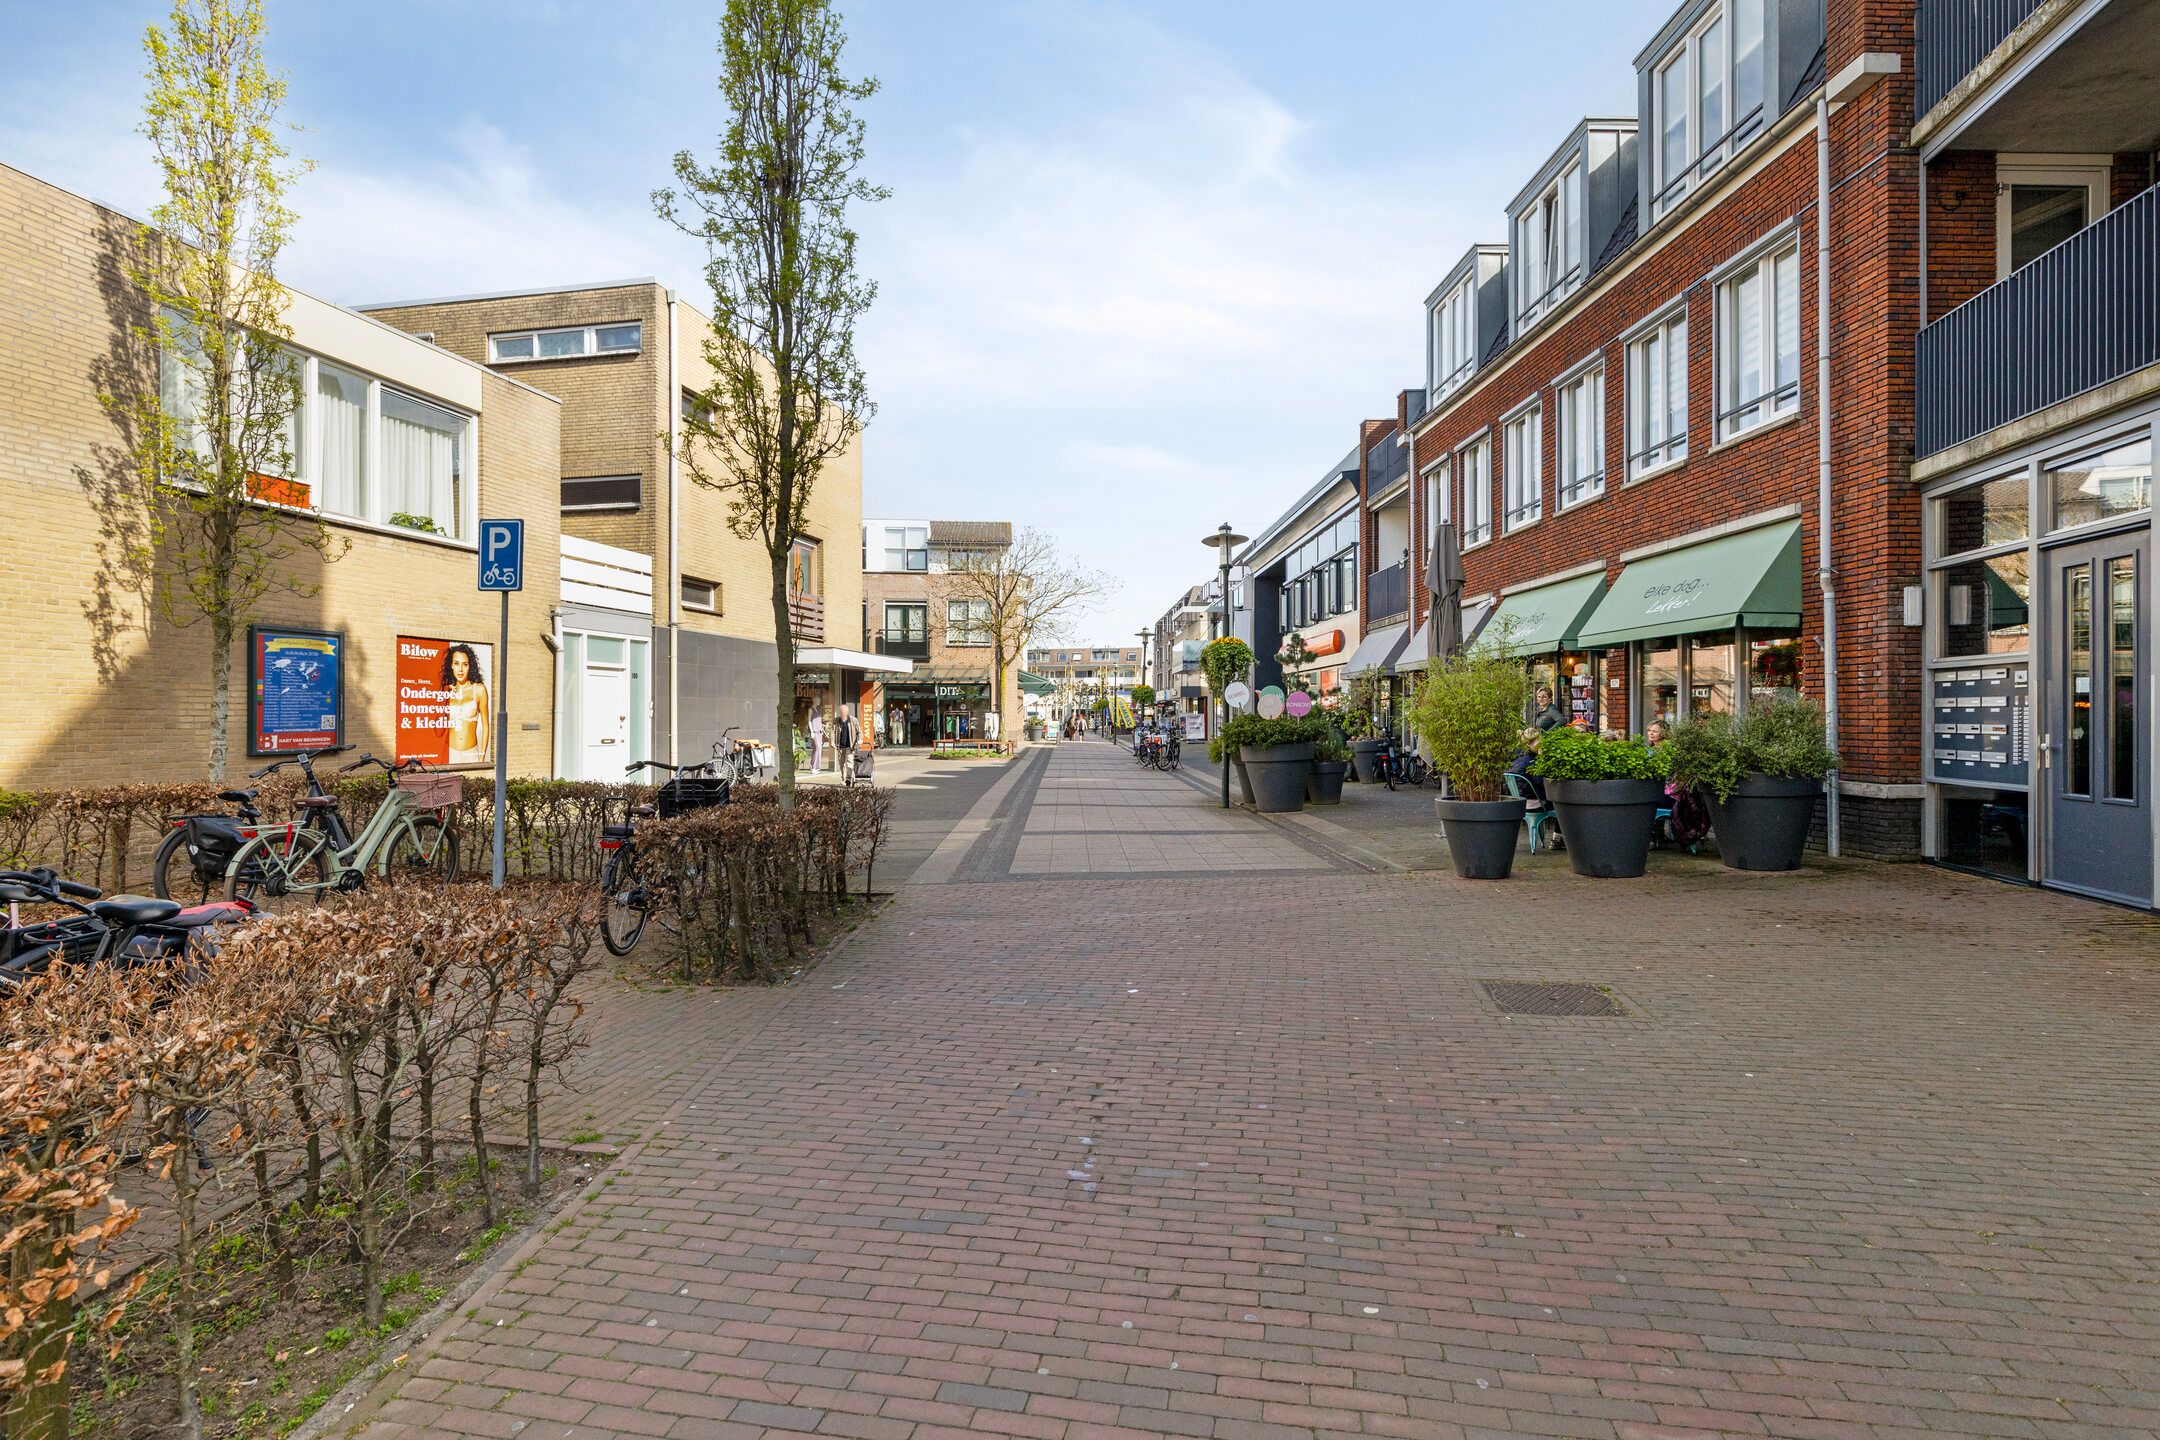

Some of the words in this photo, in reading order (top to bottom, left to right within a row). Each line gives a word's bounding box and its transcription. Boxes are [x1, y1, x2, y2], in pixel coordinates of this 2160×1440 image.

[489, 527, 511, 561] P
[1644, 586, 1671, 599] elke
[400, 643, 439, 658] Bilow
[400, 686, 463, 702] Ondergoed
[400, 701, 462, 714] homewe
[400, 717, 412, 729] &
[416, 716, 462, 731] kleding
[863, 703, 873, 739] Bilow
